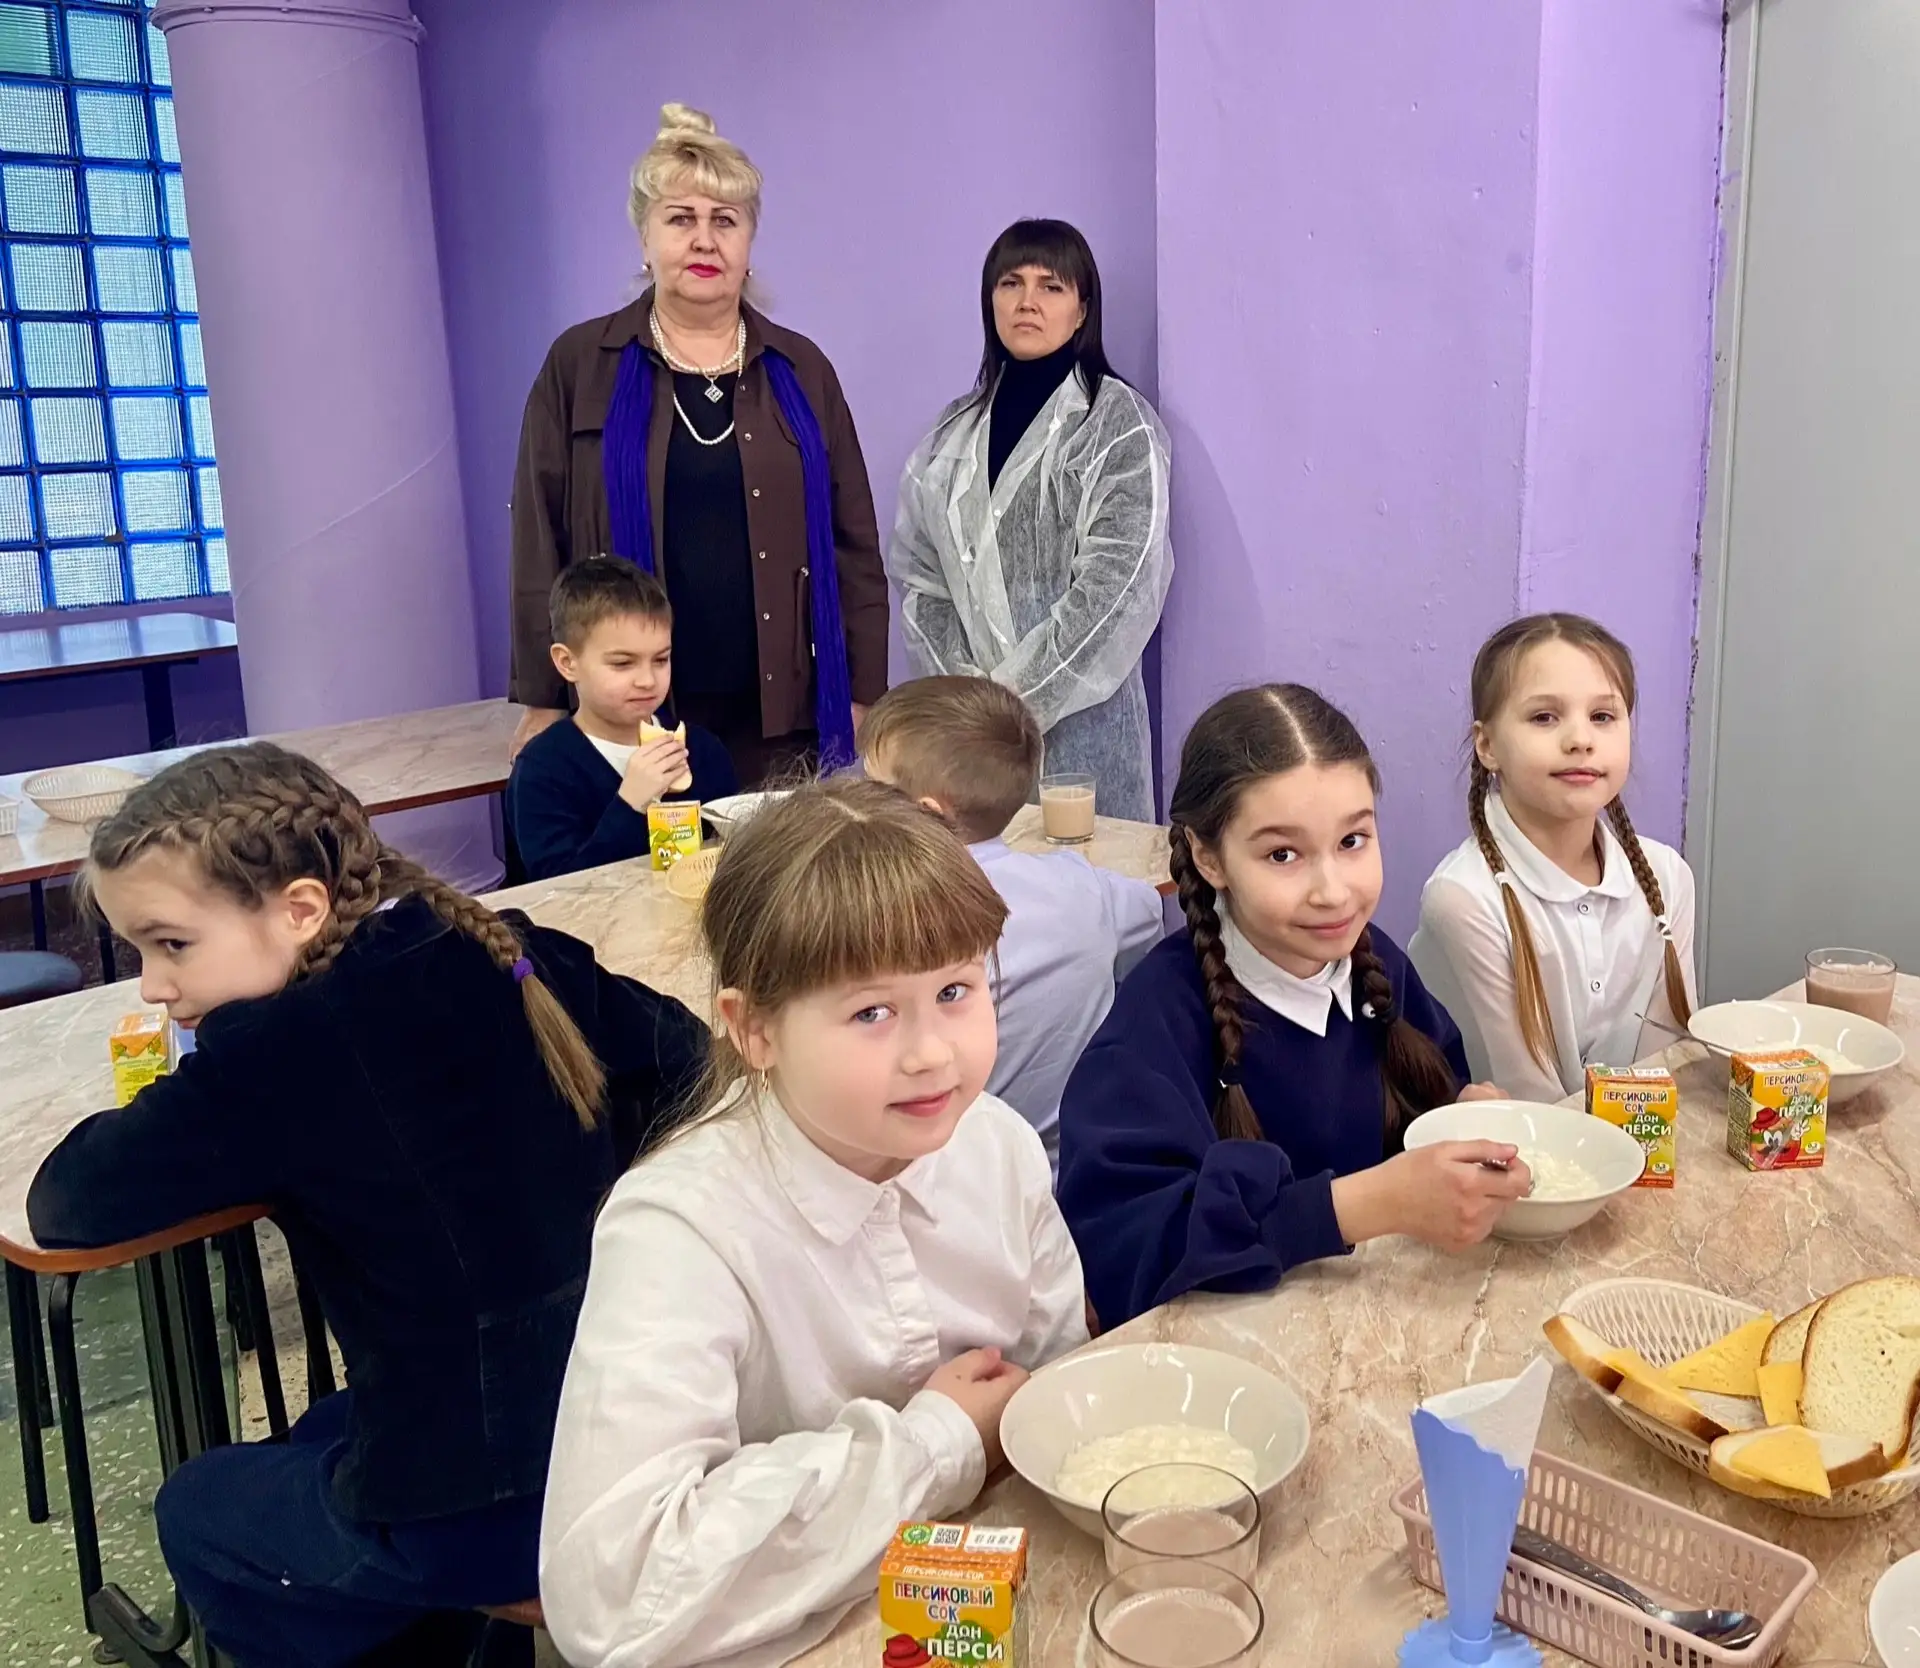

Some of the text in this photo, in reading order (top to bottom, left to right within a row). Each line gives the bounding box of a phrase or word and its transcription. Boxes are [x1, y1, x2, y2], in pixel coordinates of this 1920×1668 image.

[1603, 1090, 1668, 1103] ПЕРСИКОВЫЙ
[1624, 1103, 1645, 1114] СОК
[1779, 1104, 1824, 1117] ПЕРСИ
[1635, 1115, 1659, 1123] ДОН
[1622, 1124, 1672, 1136] ПЕРСИ
[895, 1582, 994, 1606] ПЕРСИКОВЫЙ
[927, 1604, 959, 1622] СОК
[946, 1624, 982, 1639] ДОН
[926, 1639, 1004, 1661] ПЕРСИ
